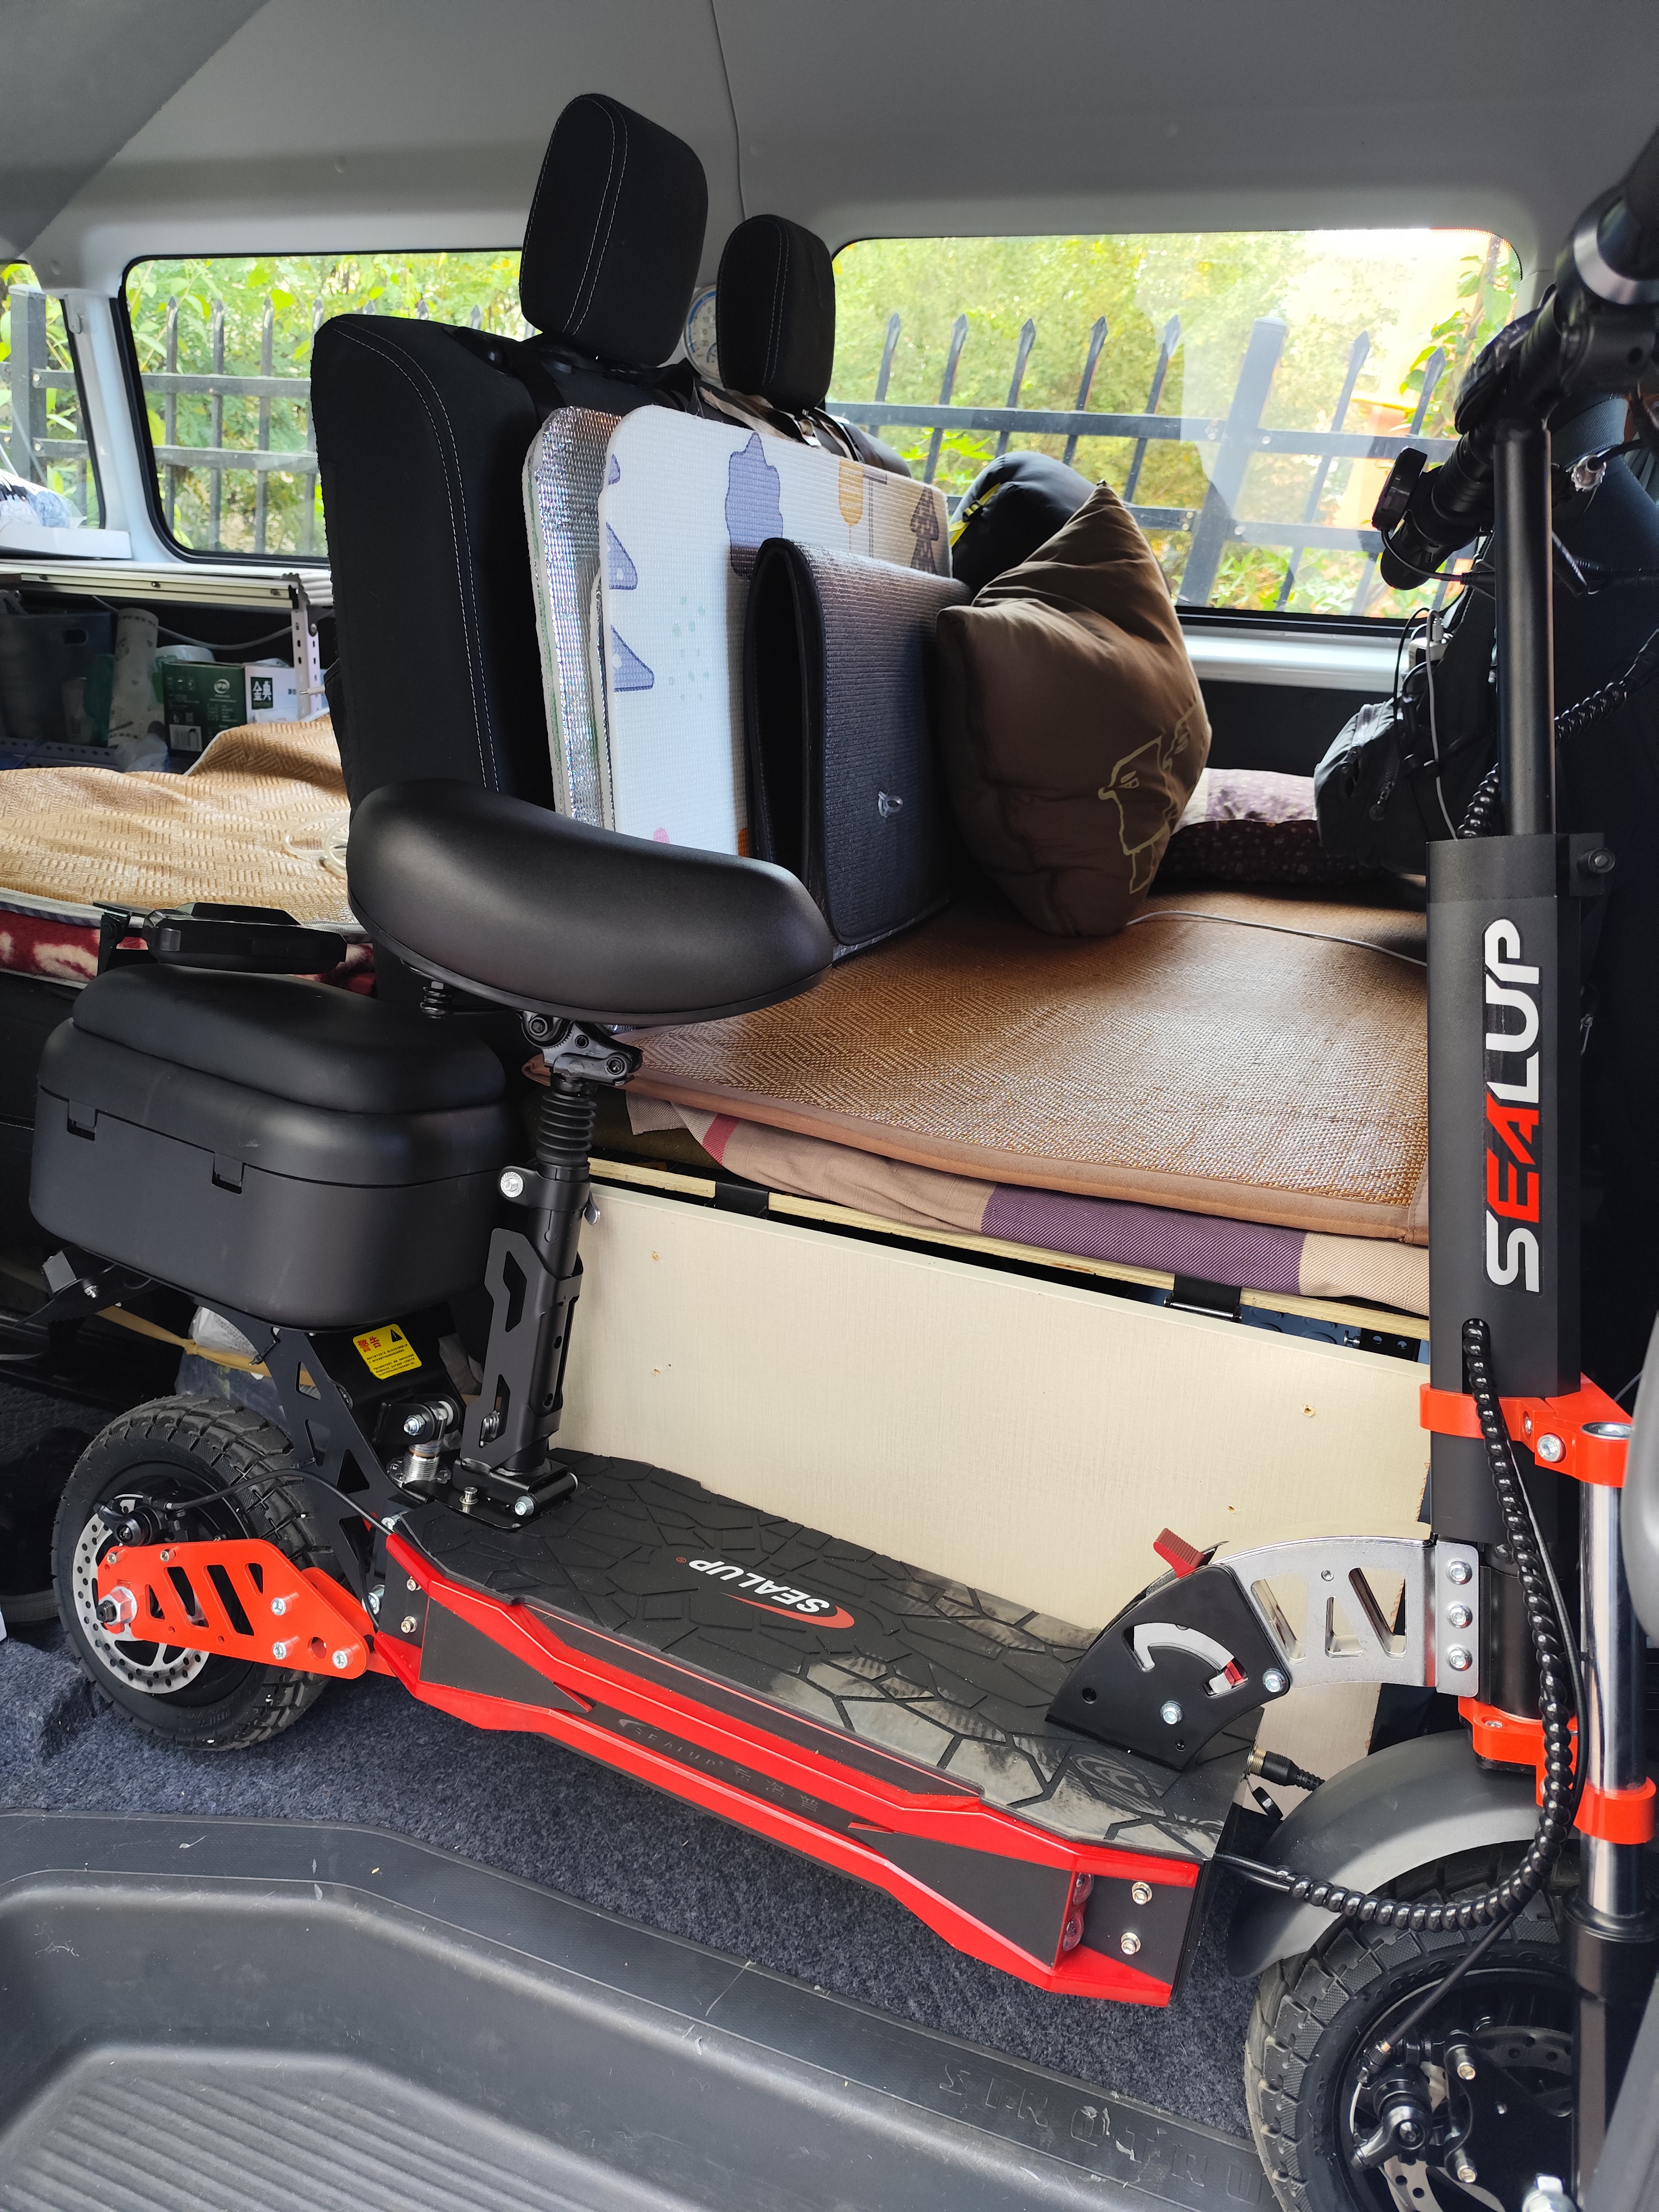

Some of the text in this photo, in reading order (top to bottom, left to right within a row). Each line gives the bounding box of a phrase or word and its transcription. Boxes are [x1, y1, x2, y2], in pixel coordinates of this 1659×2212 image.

[252, 680, 272, 701] 金典
[1484, 918, 1539, 1293] SEALUP
[357, 1336, 382, 1353] 警告
[689, 1560, 830, 1613] SEALUP
